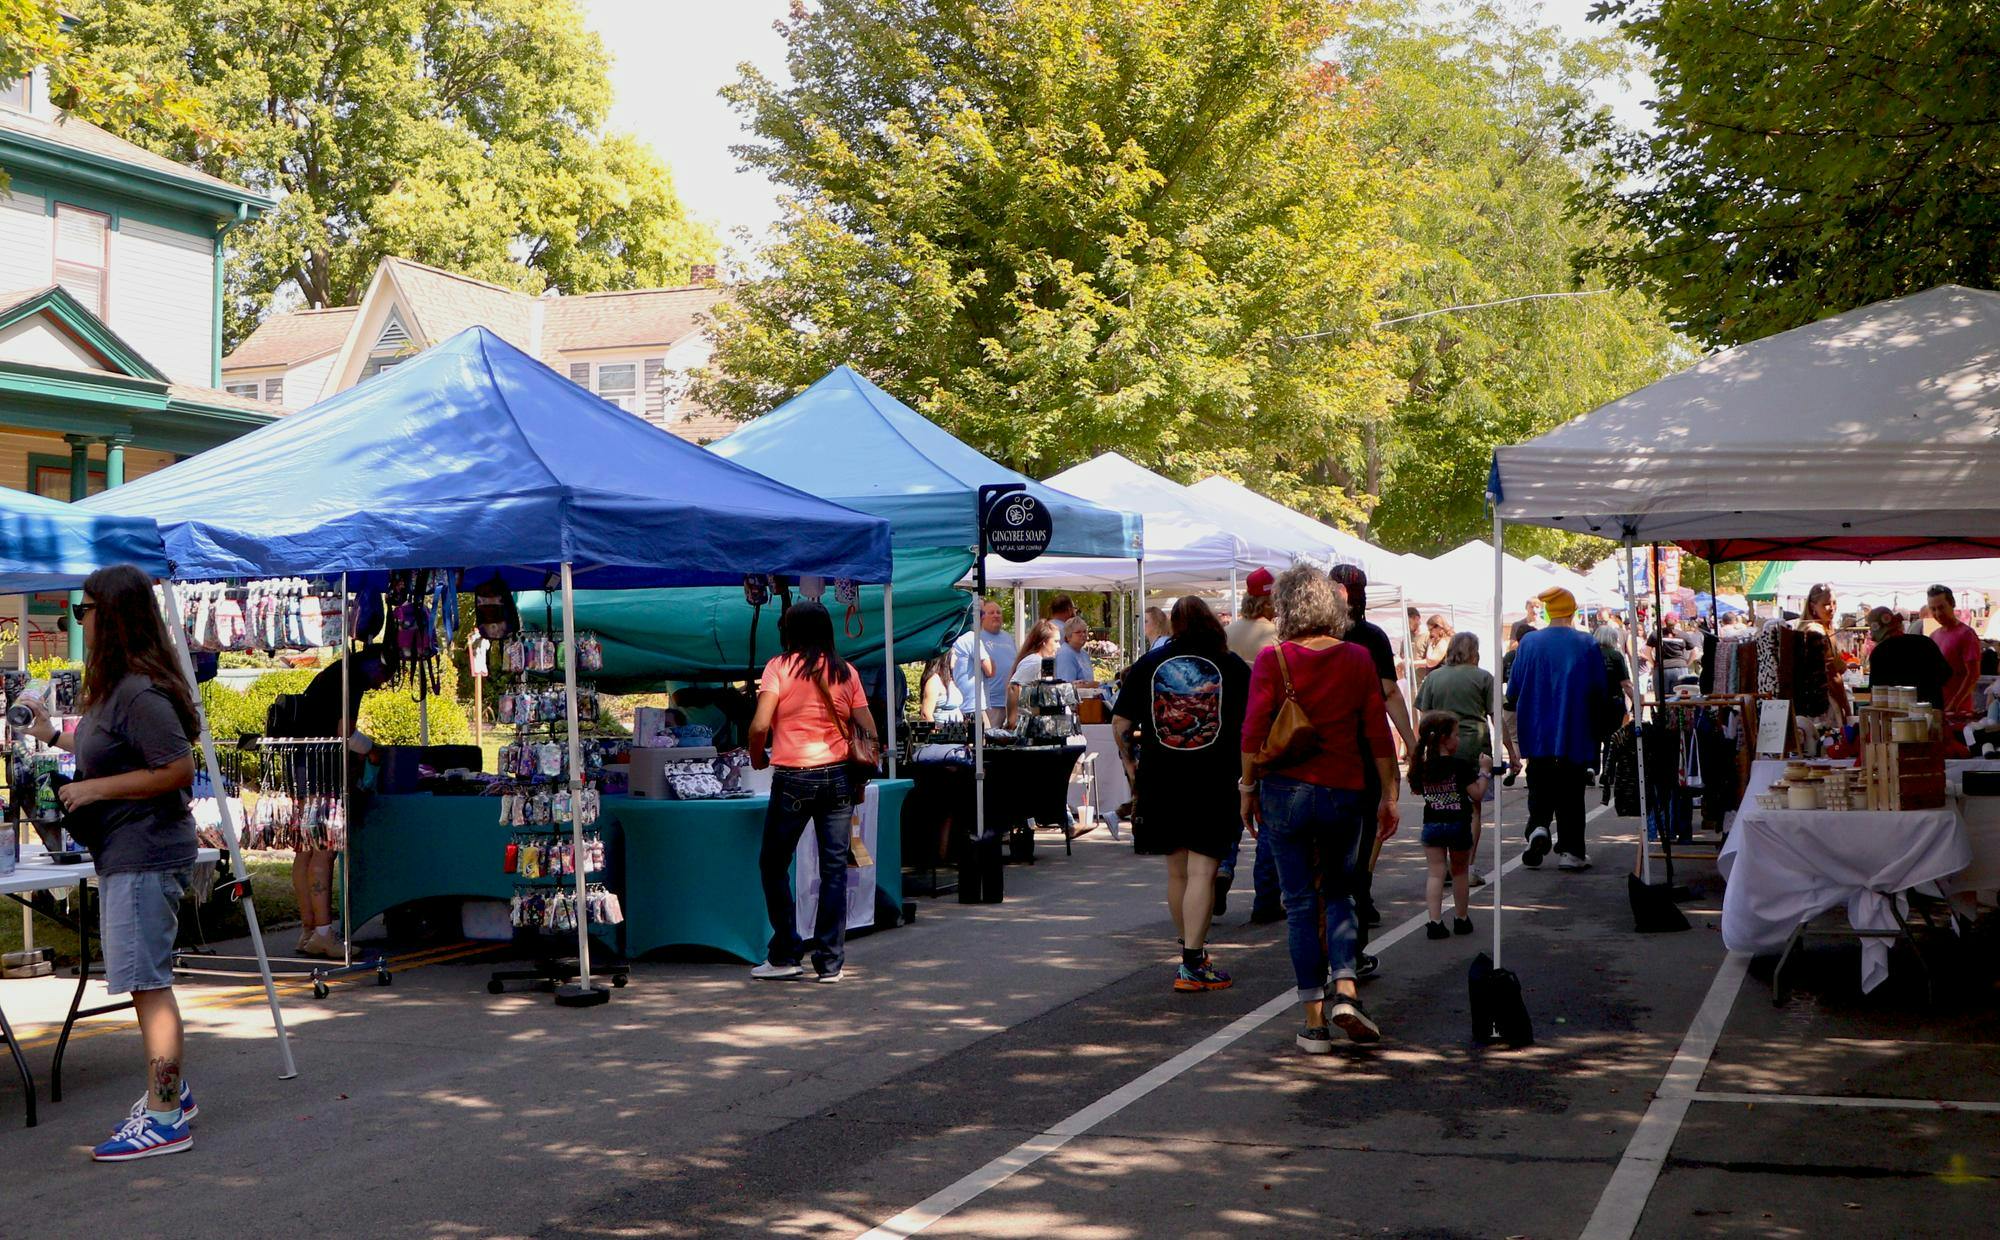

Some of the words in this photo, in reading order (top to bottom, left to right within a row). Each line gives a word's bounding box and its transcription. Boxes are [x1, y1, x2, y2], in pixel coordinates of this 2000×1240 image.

[992, 530, 1024, 541] GINGYBEE
[1025, 530, 1046, 541] SOAPS
[1423, 783, 1457, 794] PATIENCE
[1431, 802, 1461, 810] TESTER
